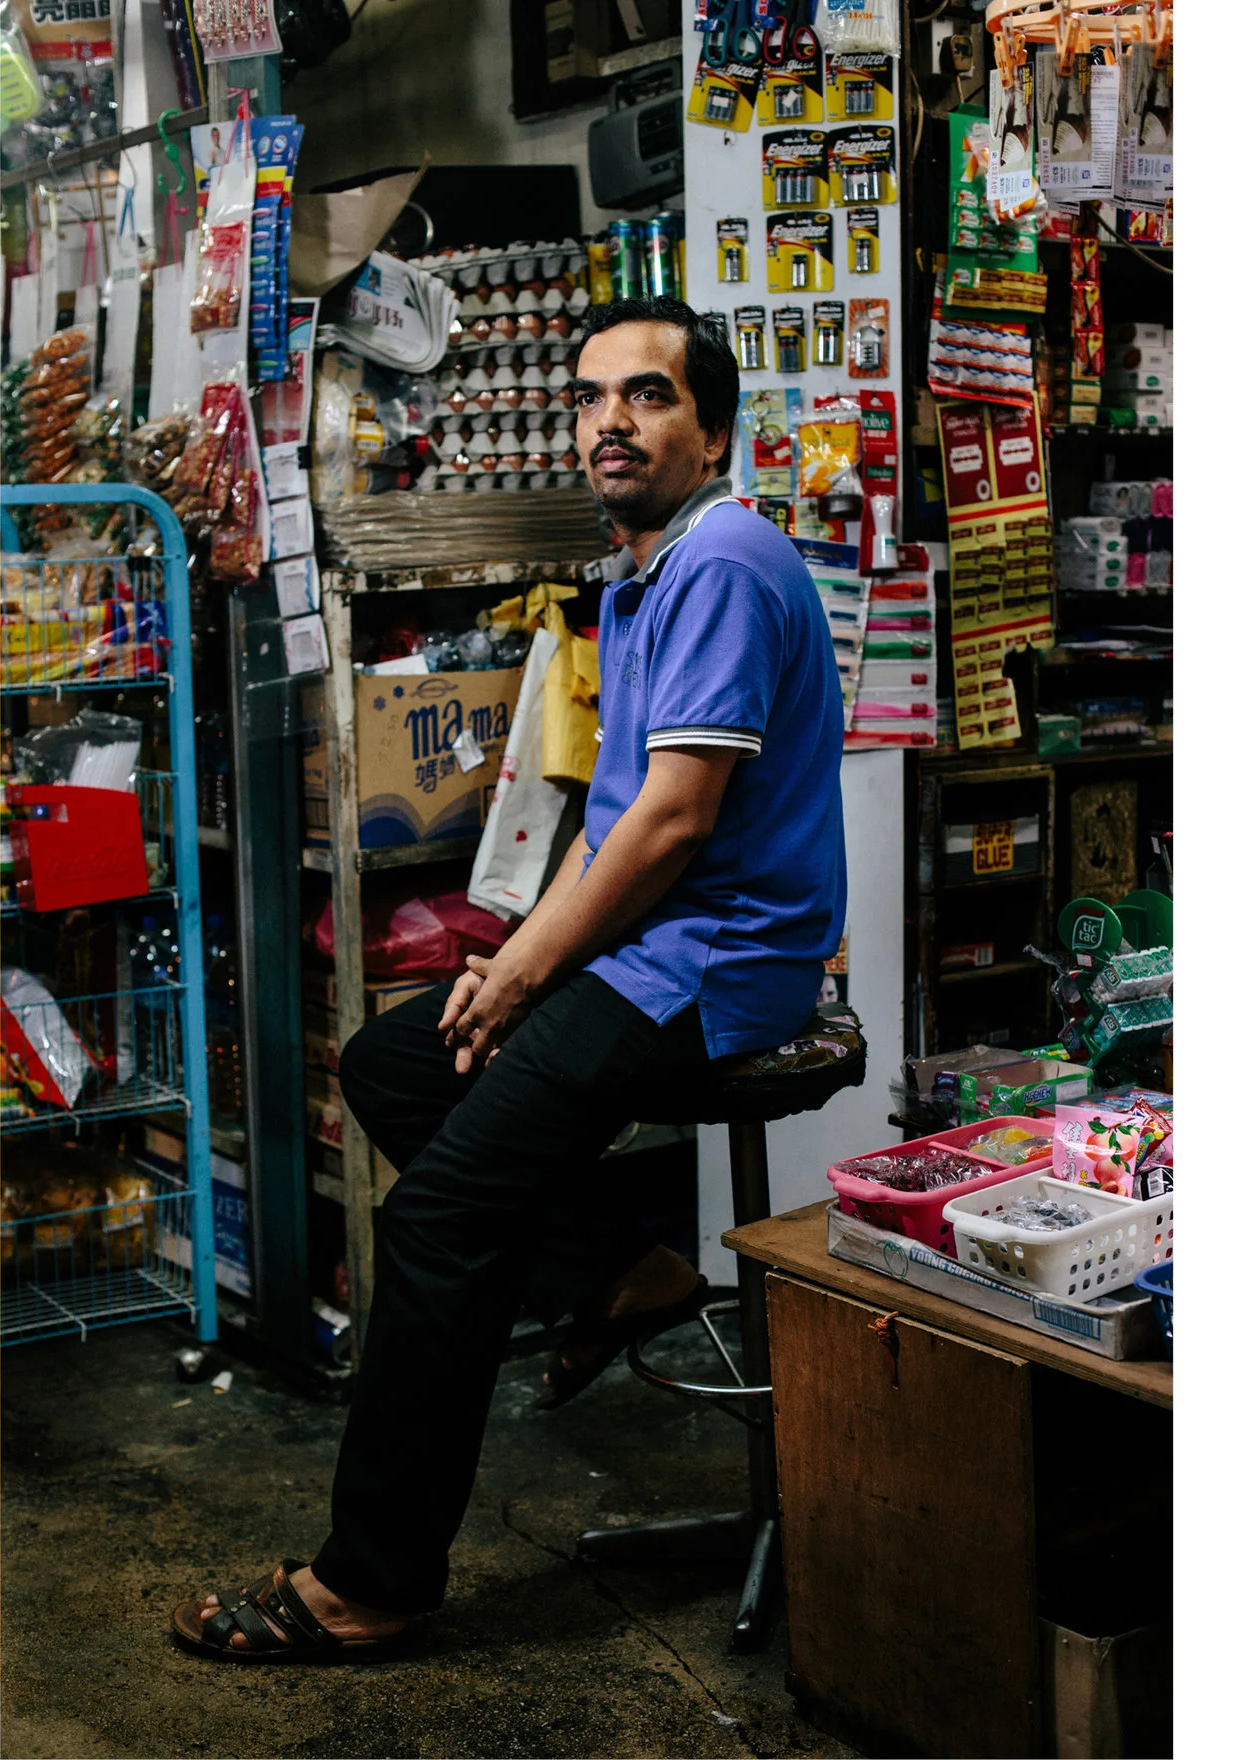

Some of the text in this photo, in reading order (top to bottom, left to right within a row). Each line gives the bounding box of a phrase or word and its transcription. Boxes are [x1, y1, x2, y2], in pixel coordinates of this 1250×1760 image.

[830, 54, 888, 68] Energizer
[766, 142, 824, 158] Energizer
[832, 138, 890, 155] Energizer
[770, 223, 829, 241] Energizer
[976, 844, 1010, 870] GLUE
[1082, 921, 1098, 935] tic
[1078, 929, 1097, 944] tac
[911, 1247, 946, 1270] YOUNG
[947, 1262, 997, 1288] COCONUT
